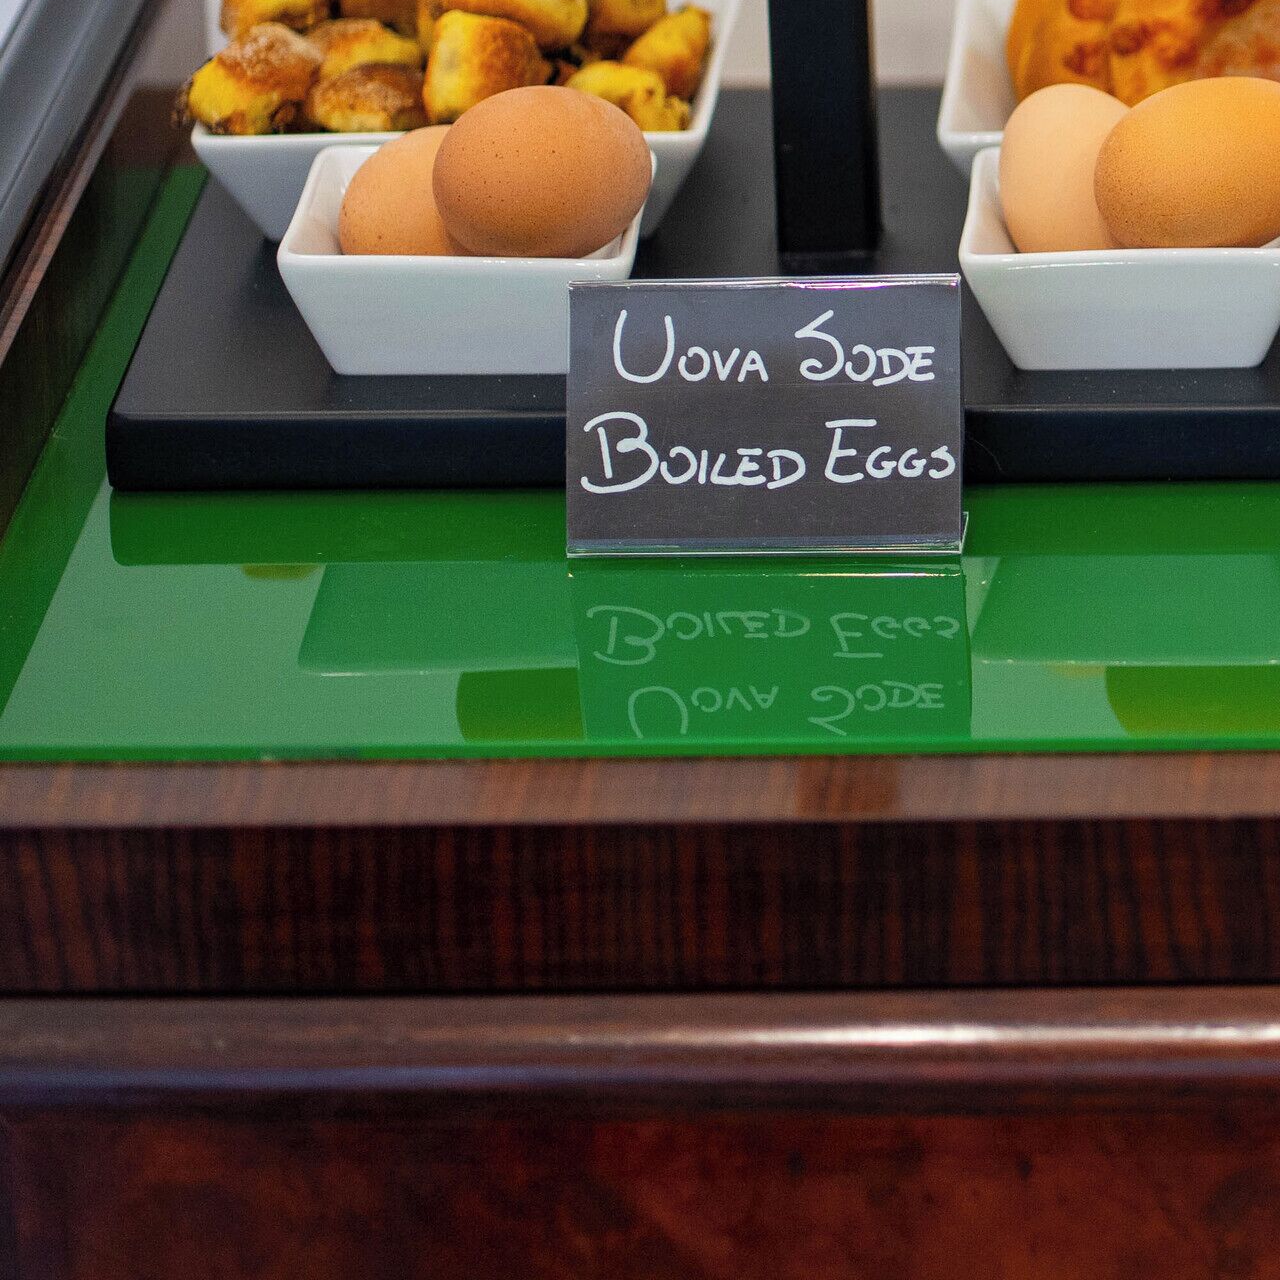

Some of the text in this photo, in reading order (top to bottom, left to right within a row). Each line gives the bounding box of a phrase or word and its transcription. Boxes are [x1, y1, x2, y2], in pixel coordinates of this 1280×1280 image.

[613, 309, 937, 387] UOVA SODE
[580, 411, 956, 495] BOILED EGGS
